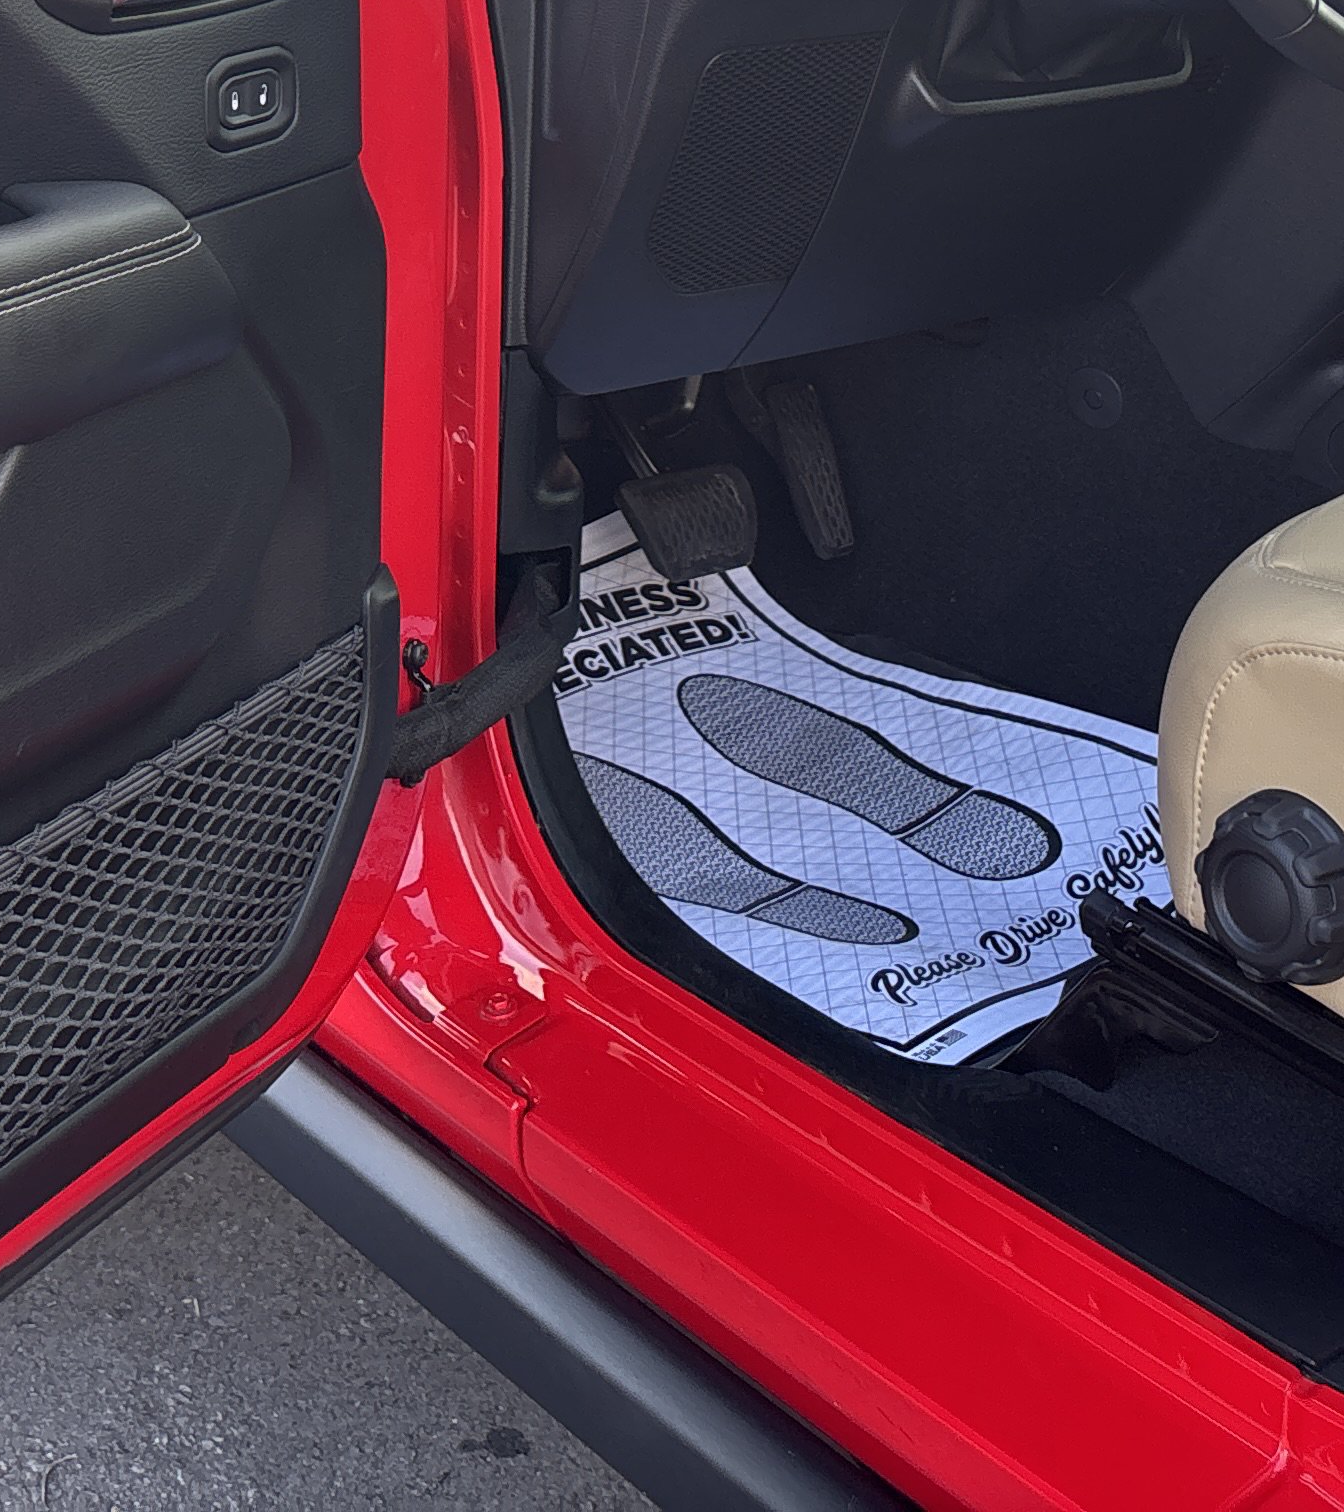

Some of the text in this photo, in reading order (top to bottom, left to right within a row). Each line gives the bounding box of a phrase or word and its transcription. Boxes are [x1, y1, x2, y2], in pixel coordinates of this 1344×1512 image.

[578, 580, 702, 633] NESS
[870, 951, 979, 1007] Please
[979, 908, 1071, 966] Drive
